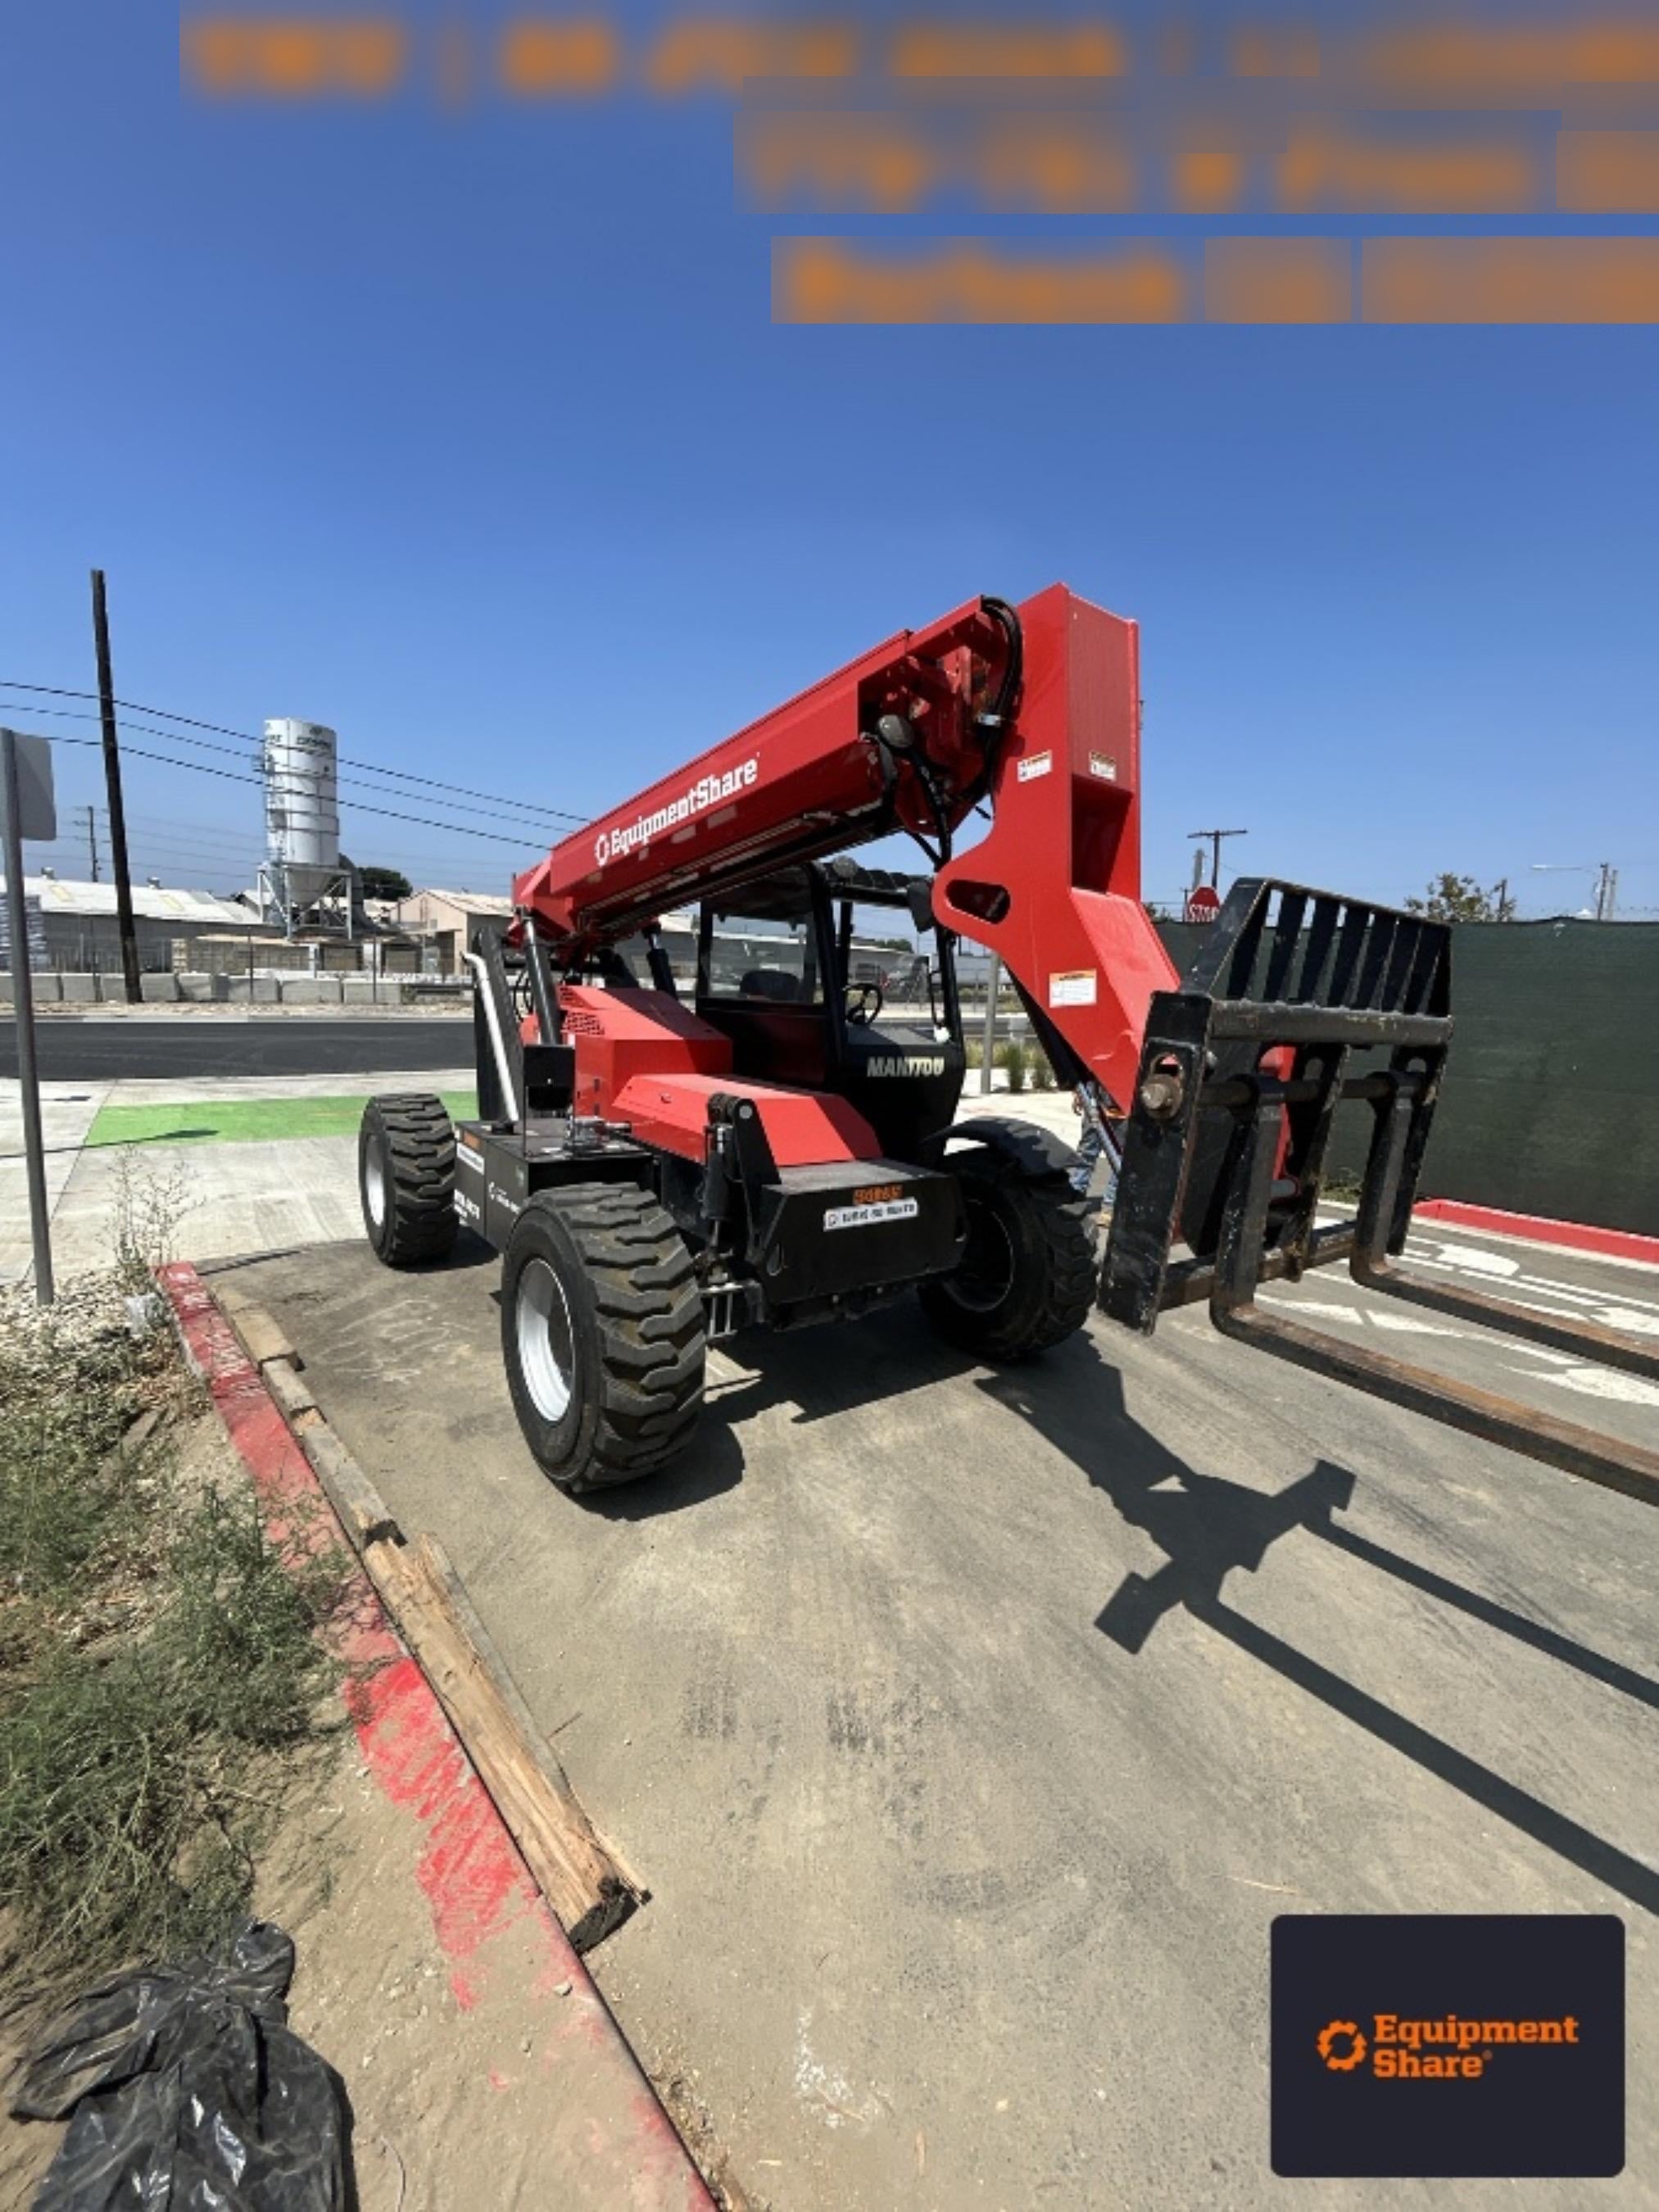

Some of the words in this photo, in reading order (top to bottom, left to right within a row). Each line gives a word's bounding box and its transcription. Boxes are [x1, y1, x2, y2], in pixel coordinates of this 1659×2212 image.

[611, 758, 758, 856] EquipmentShare
[1188, 904, 1220, 922] STOP
[868, 1056, 945, 1077] MANITOU
